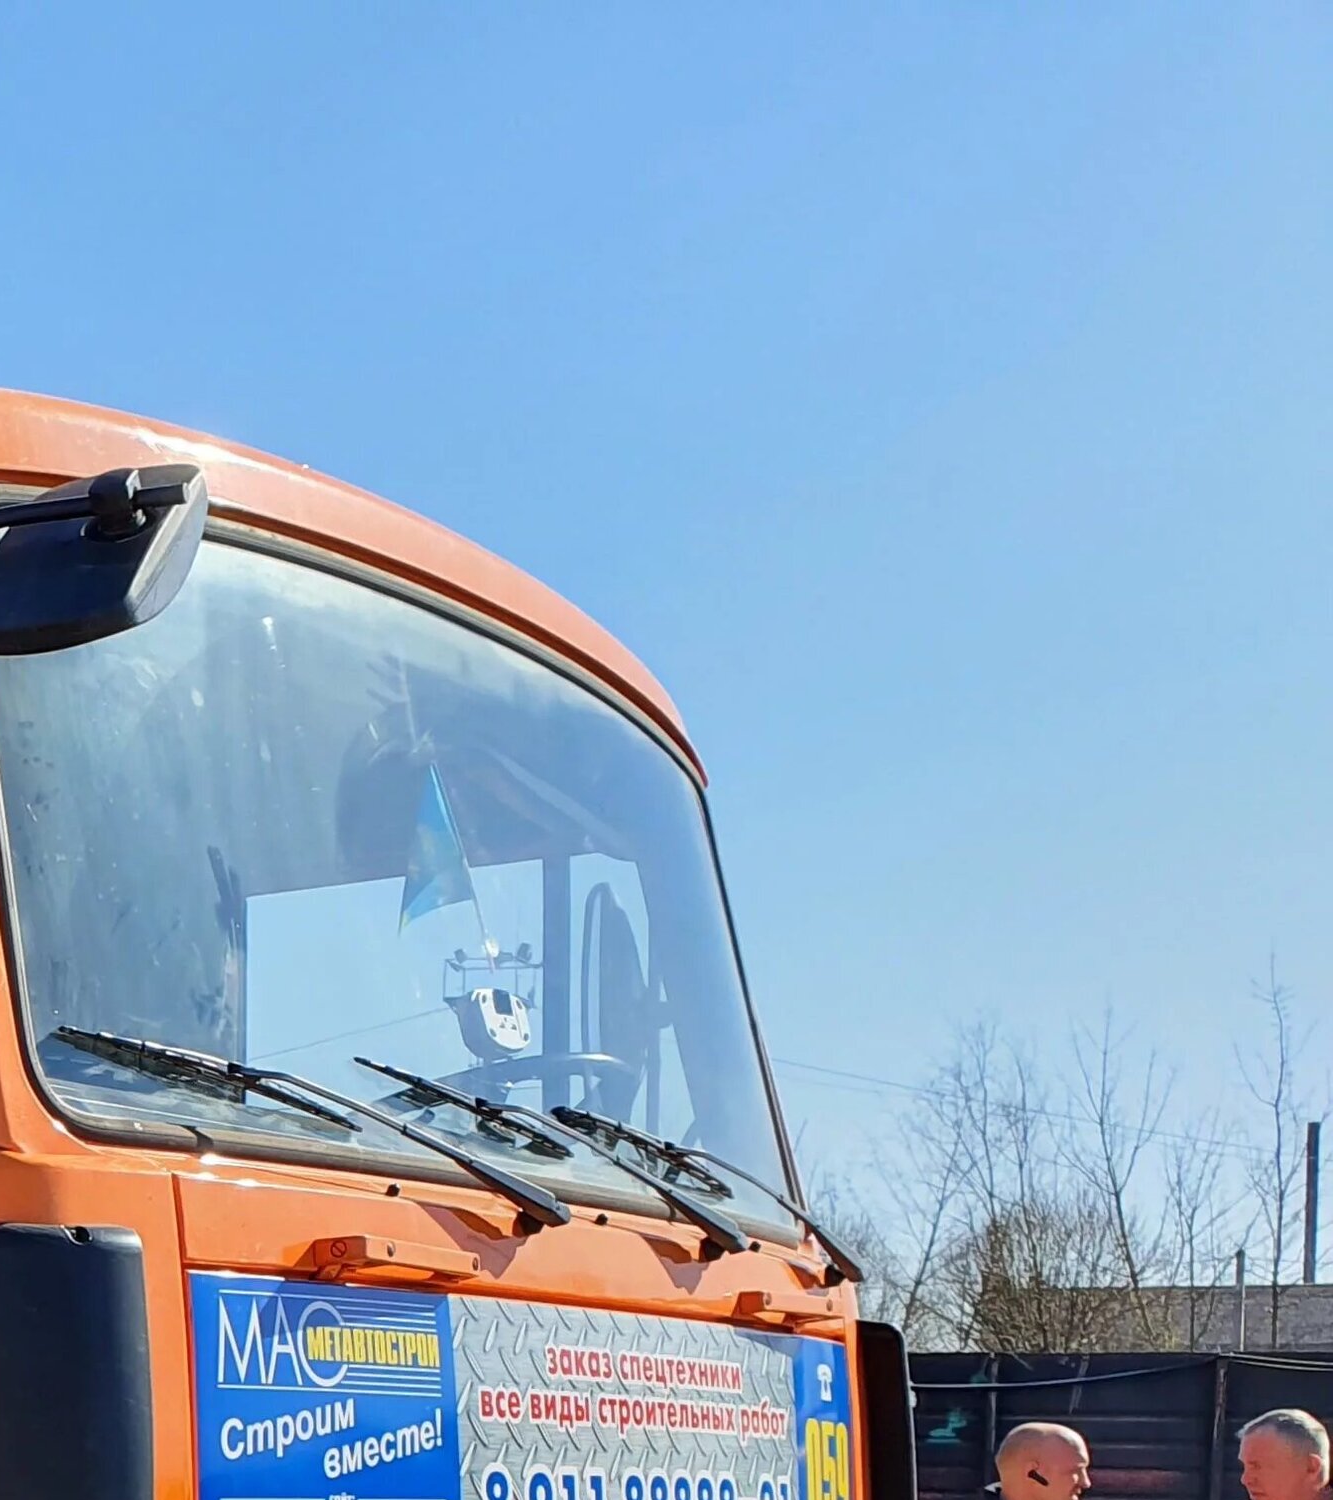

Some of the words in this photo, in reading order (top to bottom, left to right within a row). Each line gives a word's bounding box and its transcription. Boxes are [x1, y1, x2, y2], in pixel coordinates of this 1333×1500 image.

[546, 1346, 612, 1379] заказ
[619, 1354, 742, 1391] спецтехники
[220, 1398, 355, 1460] Строим
[323, 1408, 443, 1479] вместе!
[481, 1390, 522, 1418] все
[531, 1392, 591, 1428] виды
[598, 1399, 736, 1437] строительных
[740, 1399, 787, 1442] работ
